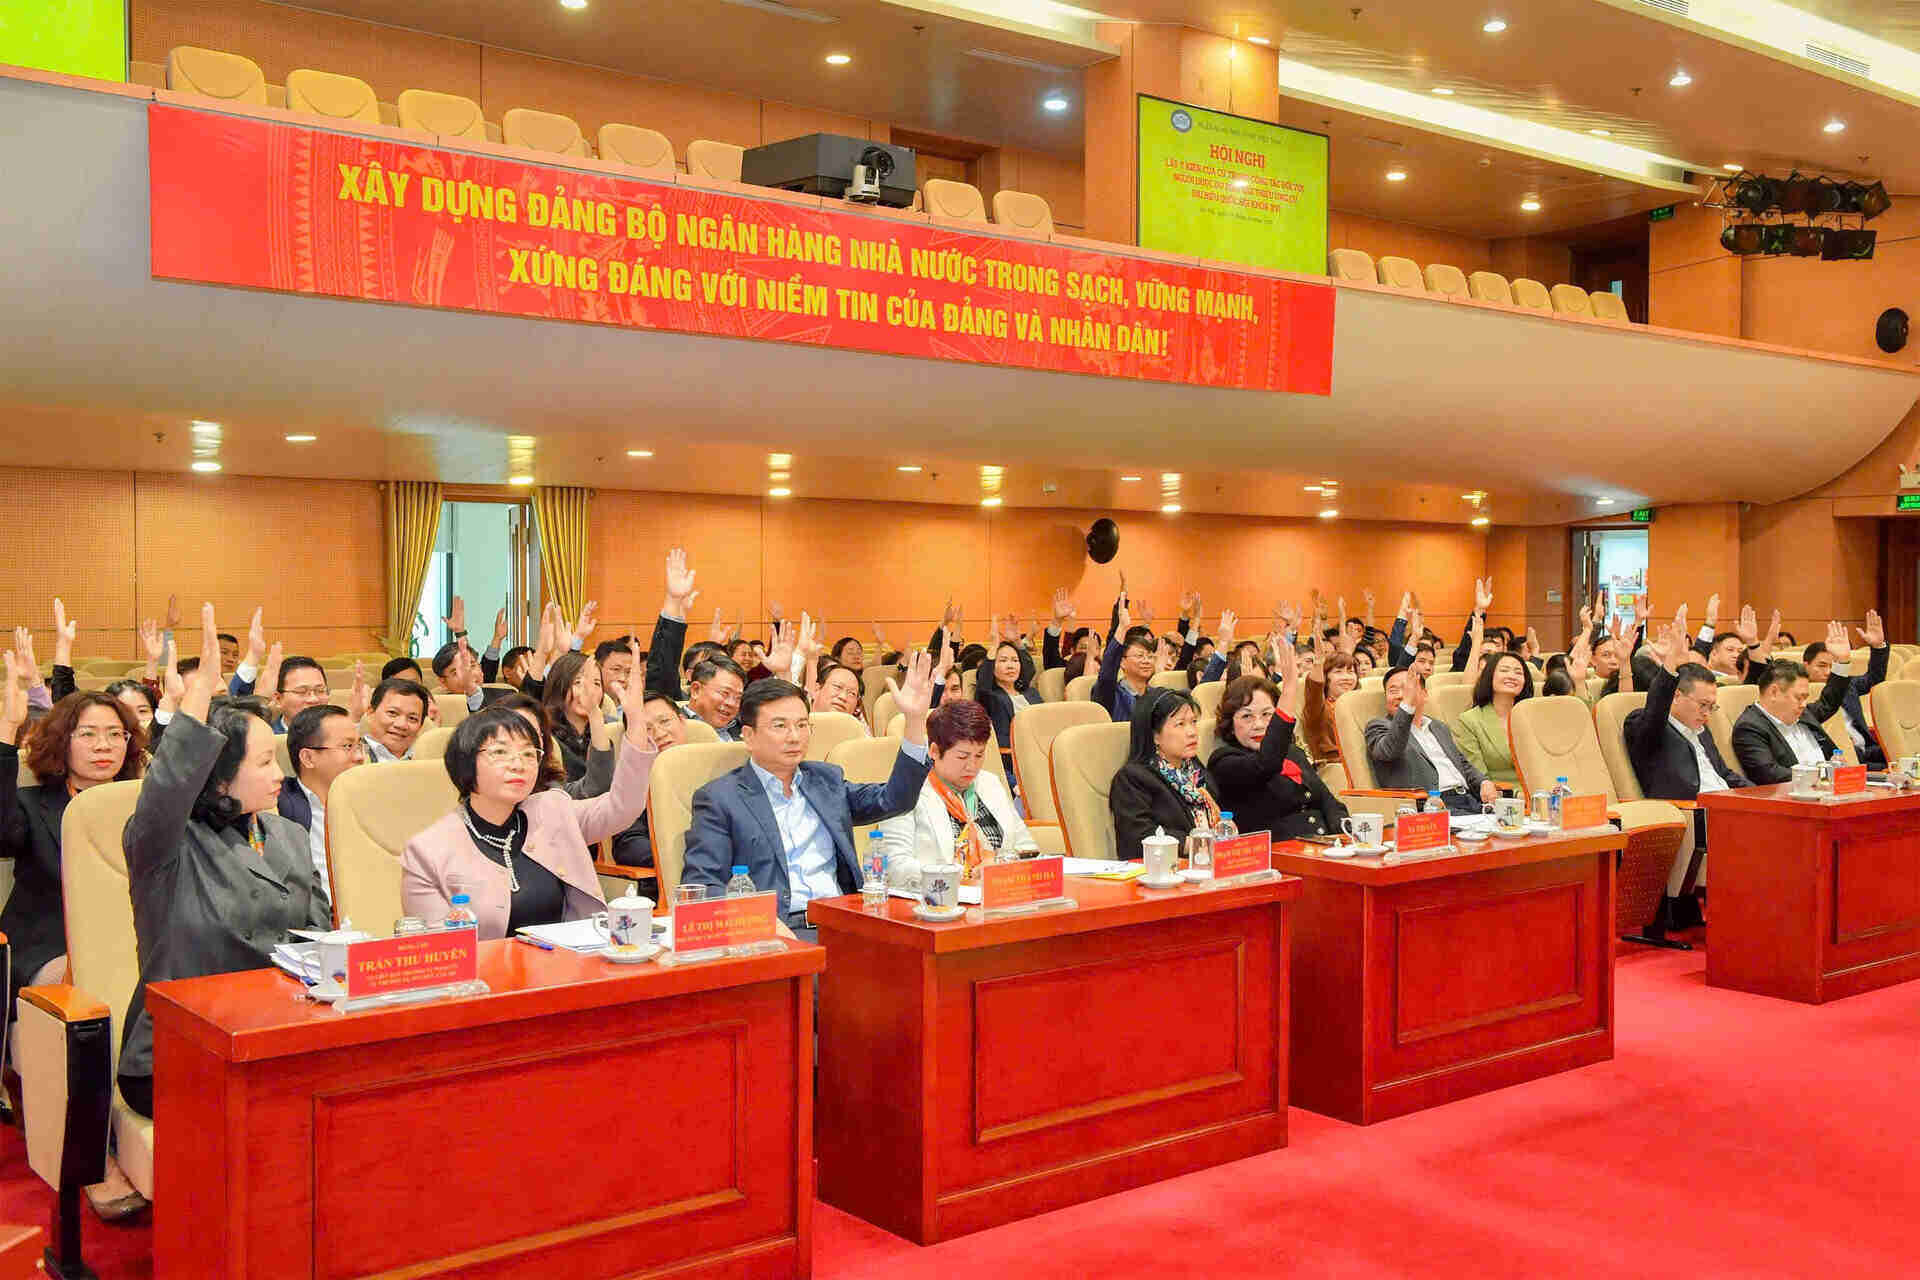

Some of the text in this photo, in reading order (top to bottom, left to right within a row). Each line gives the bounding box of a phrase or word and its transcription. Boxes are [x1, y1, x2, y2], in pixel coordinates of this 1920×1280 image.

[338, 161, 1258, 324] XÂY DỰNG ĐẢNG BỘ NGÂN HÀNG NHÀ NƯỚC TRONG SẠCH, VỮNG MẠNH,
[508, 244, 1168, 357] XỨNG ĐÁNG VỚI NIỀM TIN CỦA ĐẢNG VÀ NHÂN DÂN!
